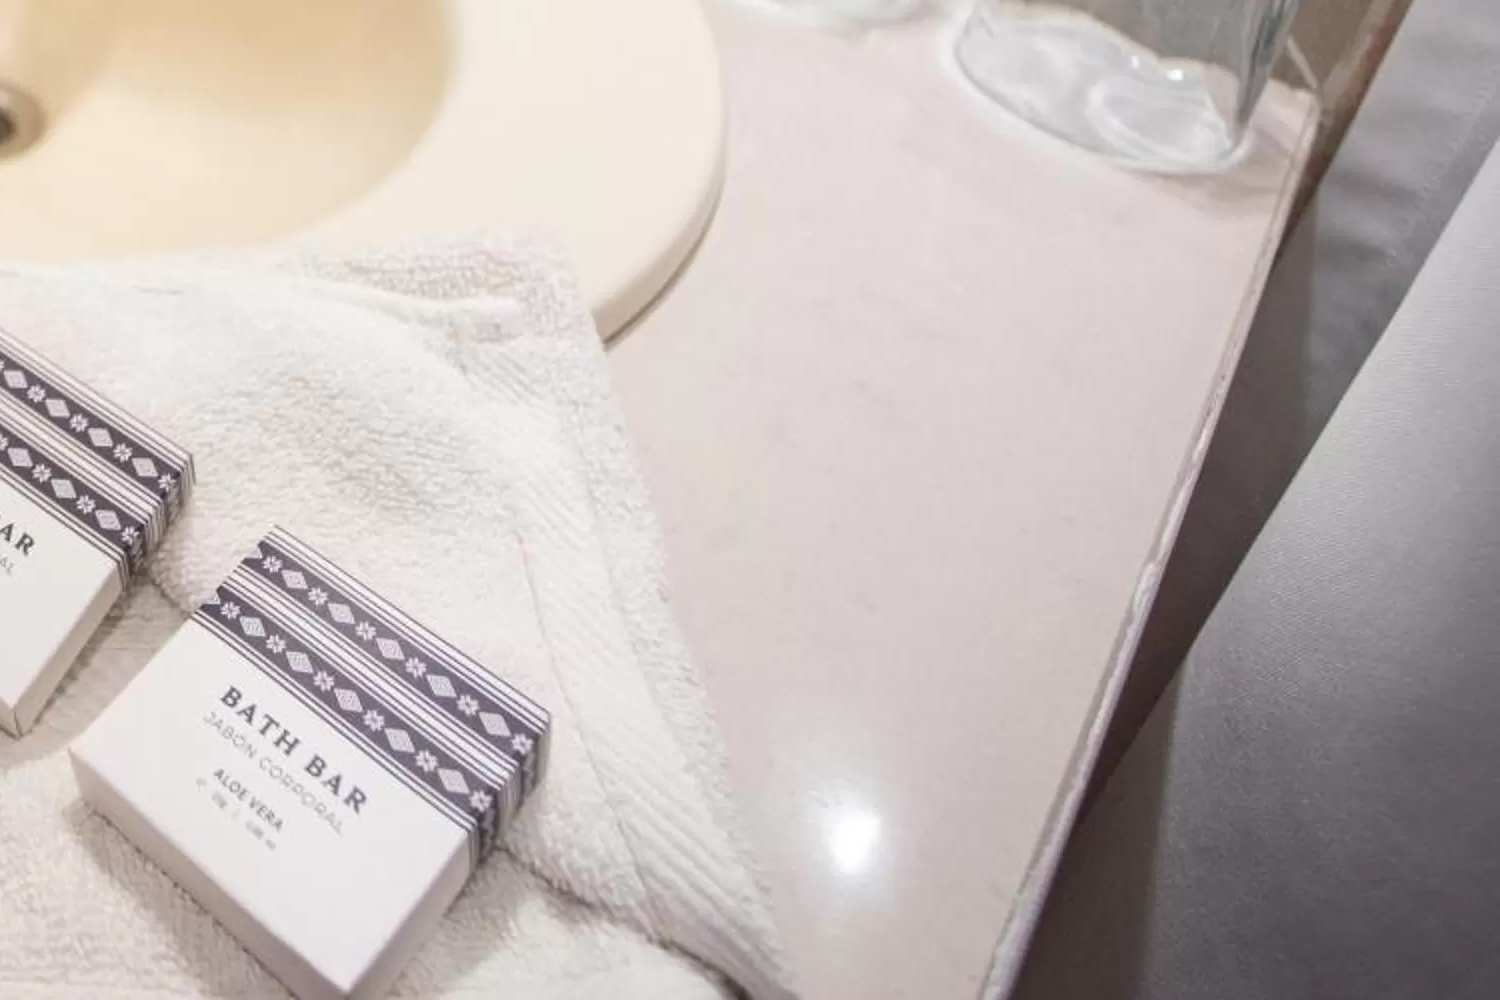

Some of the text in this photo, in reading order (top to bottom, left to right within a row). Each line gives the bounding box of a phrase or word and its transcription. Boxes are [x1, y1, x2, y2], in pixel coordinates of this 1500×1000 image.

[220, 684, 301, 757] BATH
[304, 753, 368, 815] BAR
[213, 768, 250, 802] ALOE
[249, 796, 284, 832] VERA
